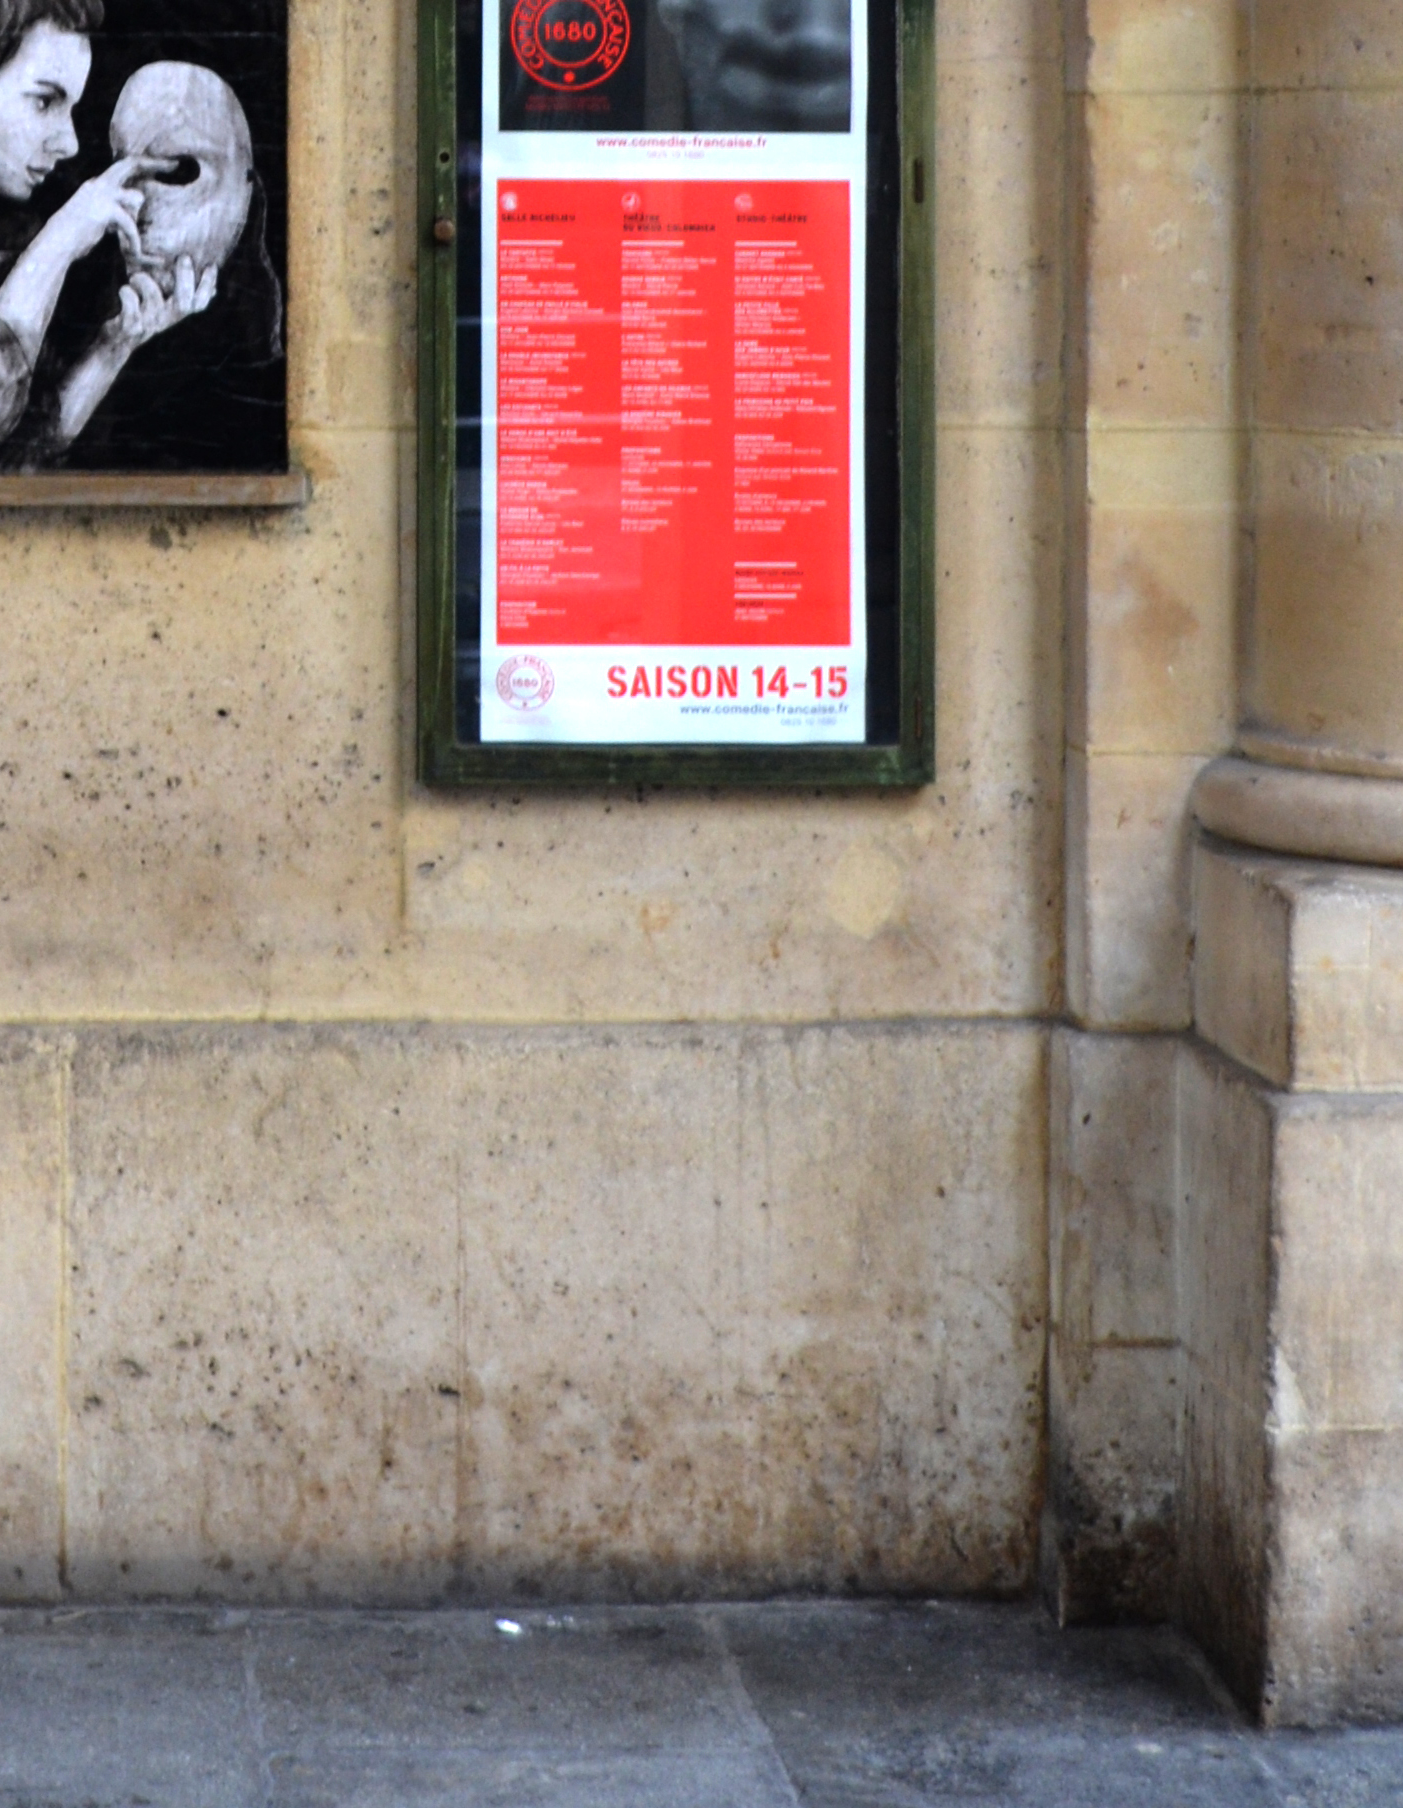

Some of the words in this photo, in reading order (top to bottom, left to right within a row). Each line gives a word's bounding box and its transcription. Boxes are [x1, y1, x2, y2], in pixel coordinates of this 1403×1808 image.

[543, 20, 597, 42] 1680
[596, 136, 767, 149] www.comedie-francaise.fr
[607, 665, 739, 699] SAISON
[752, 665, 848, 699] 14-15
[680, 702, 849, 715] www.comedie-francaise.fr
